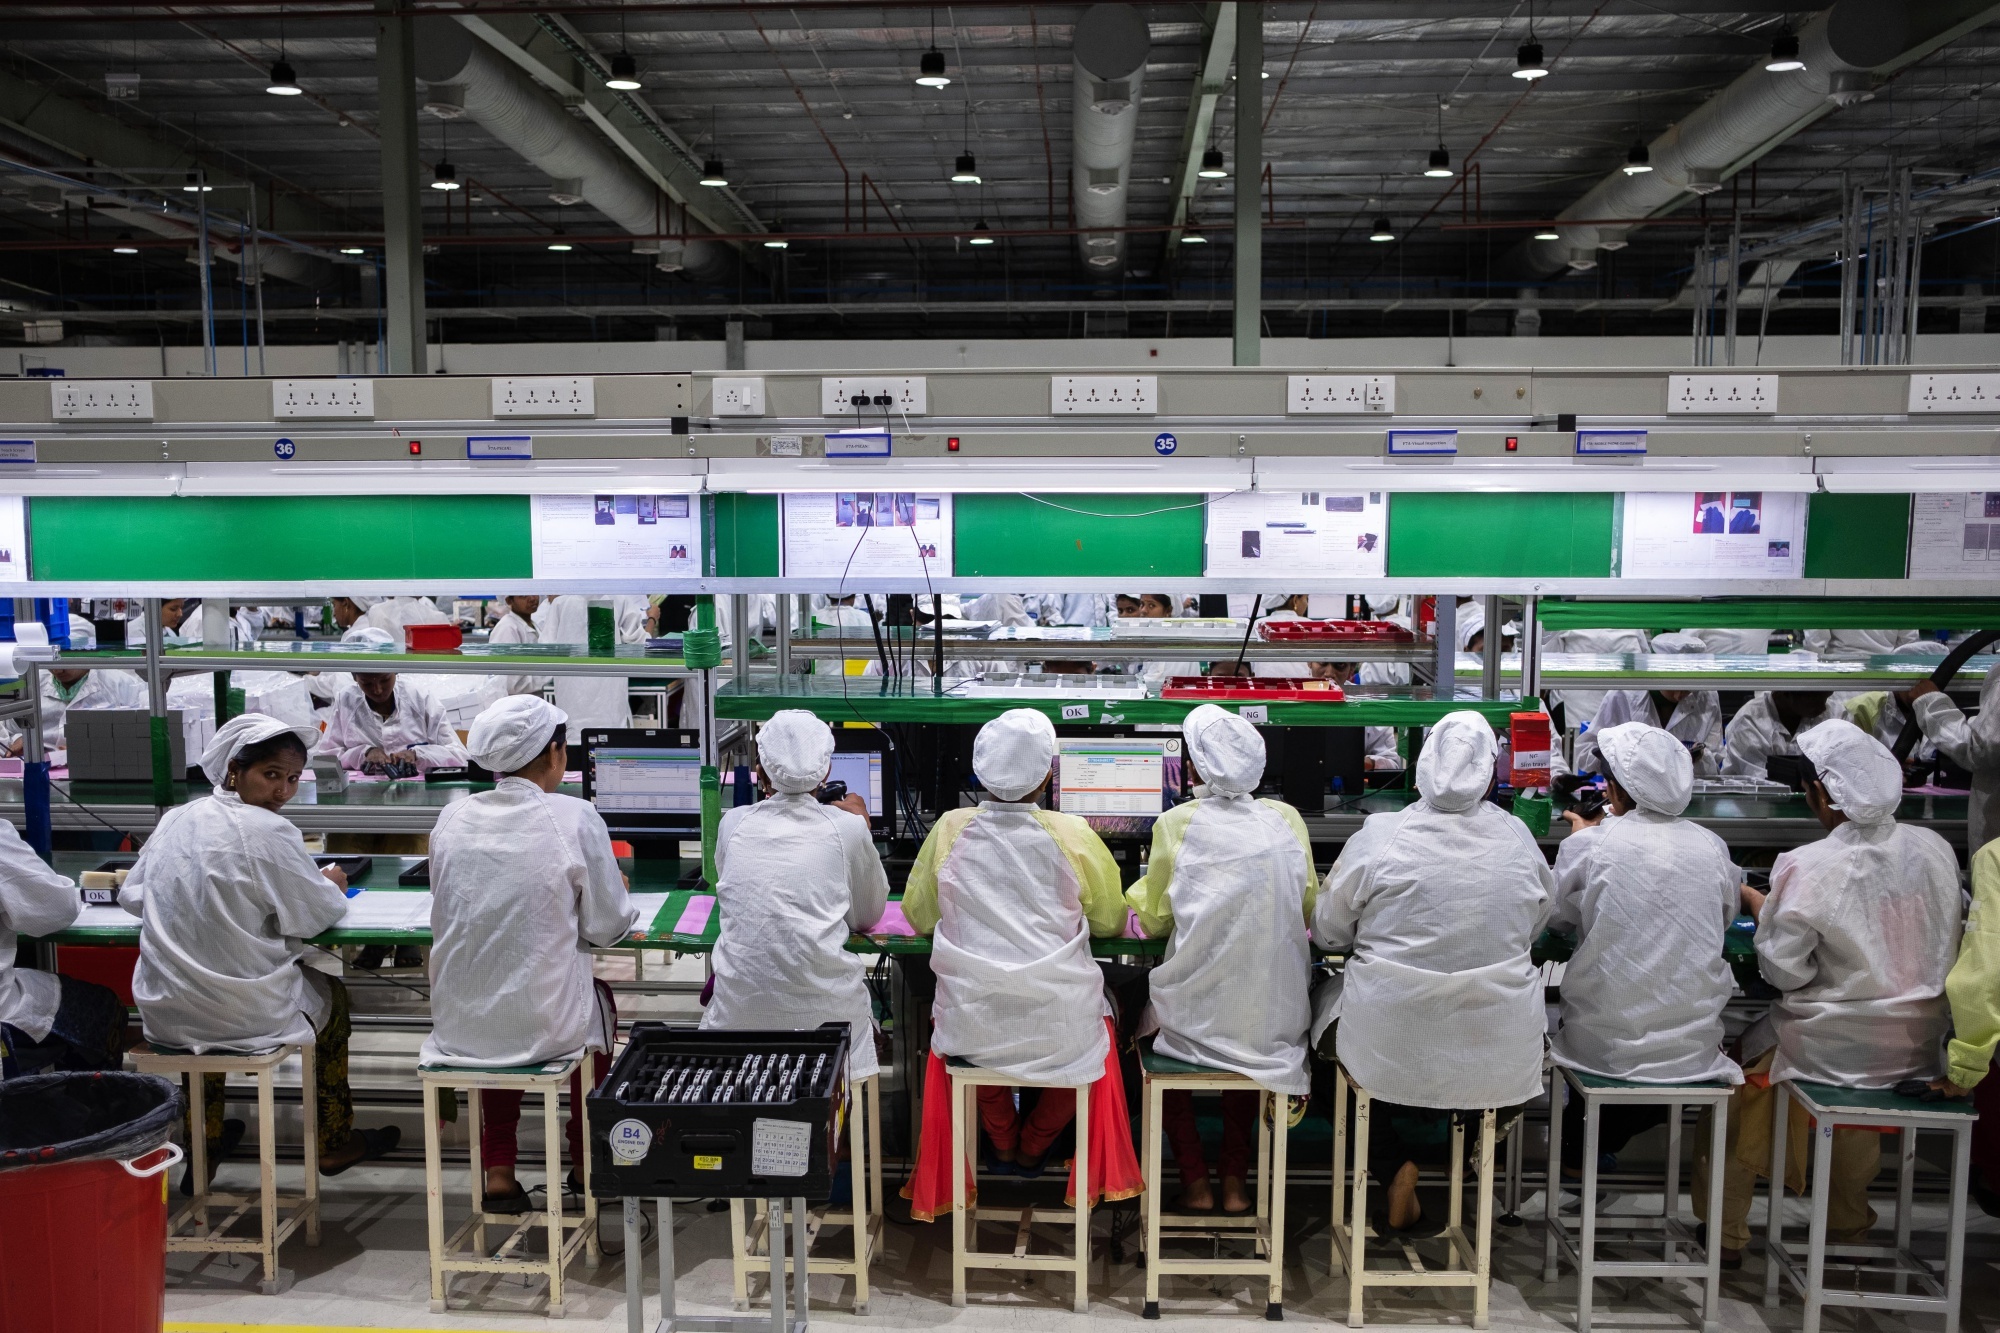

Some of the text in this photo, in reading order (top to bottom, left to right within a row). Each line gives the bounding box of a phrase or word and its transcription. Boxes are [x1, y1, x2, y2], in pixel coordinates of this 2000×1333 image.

[276, 443, 293, 454] 36
[1156, 438, 1174, 450] 35
[1066, 708, 1082, 717] OK
[623, 1127, 640, 1139] B4
